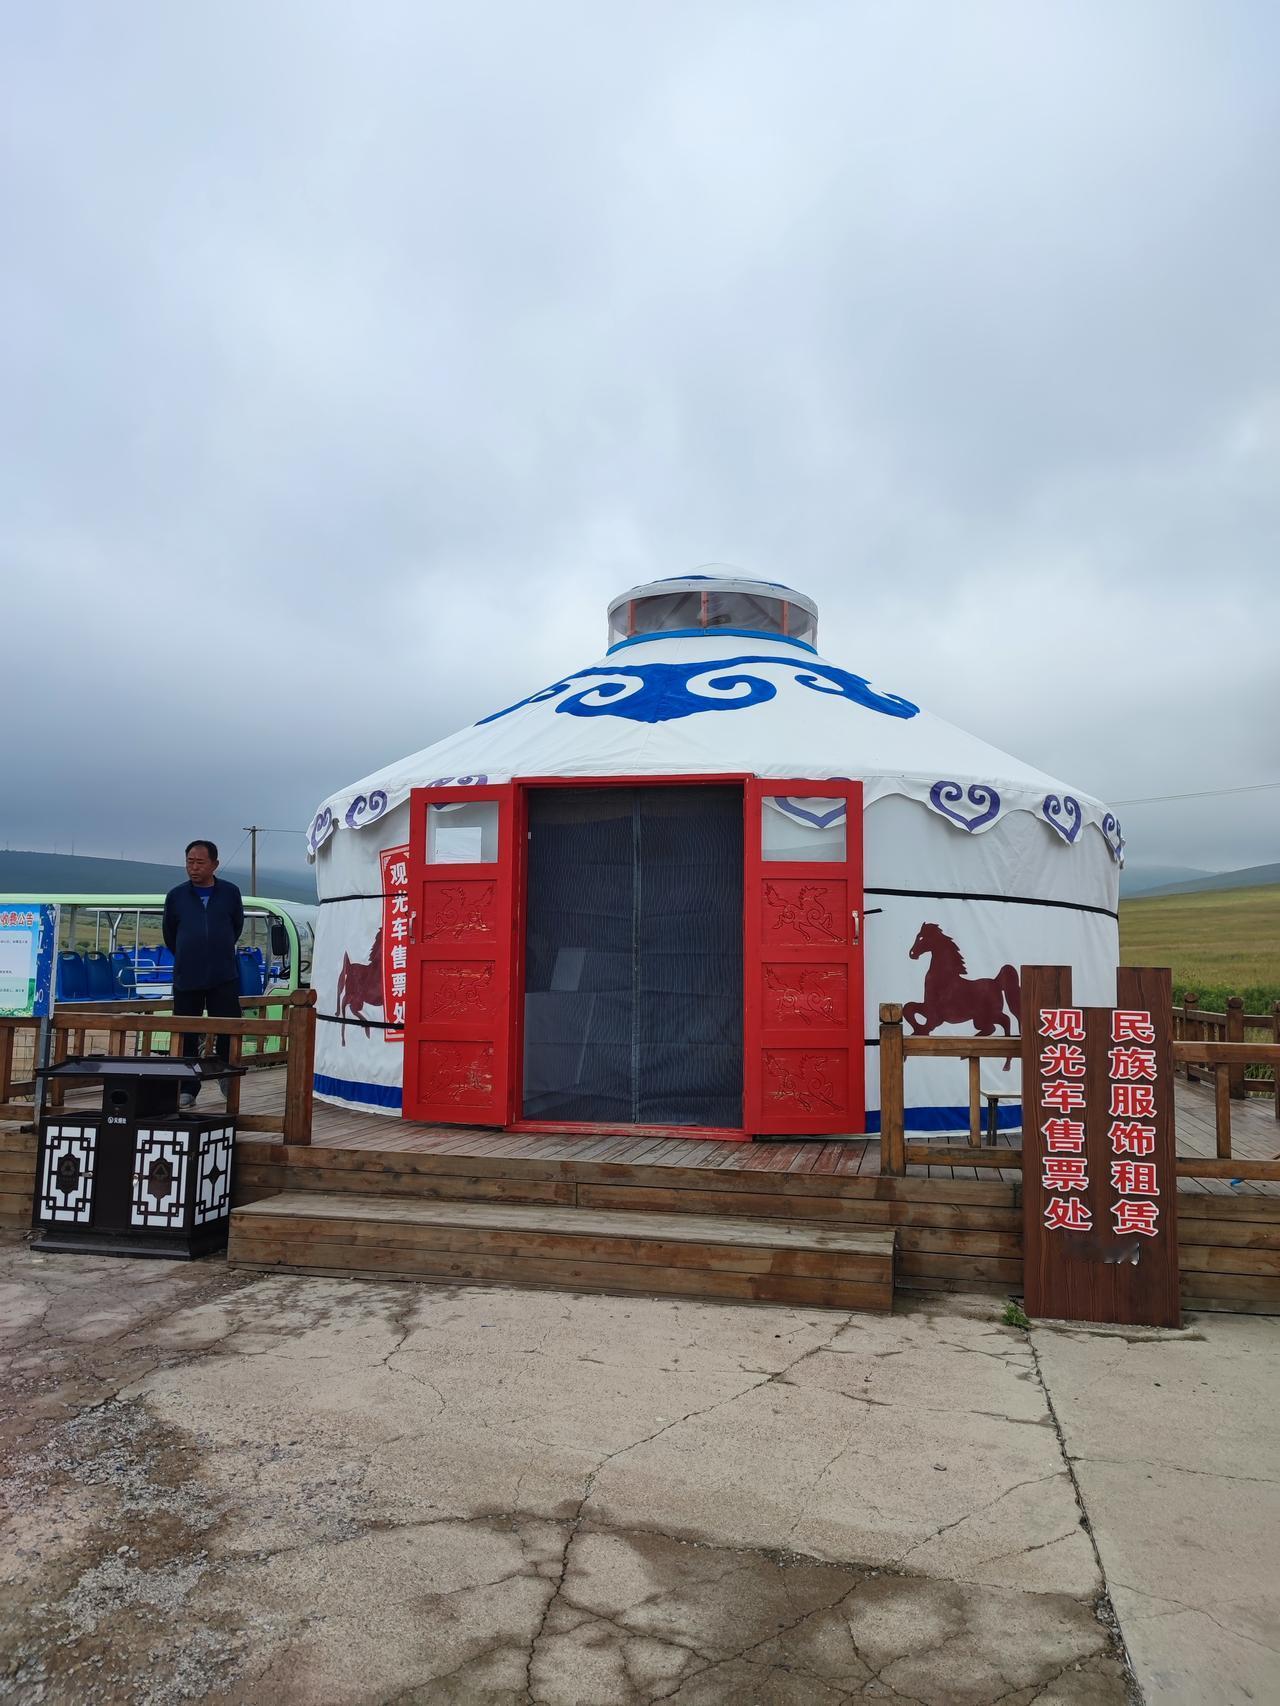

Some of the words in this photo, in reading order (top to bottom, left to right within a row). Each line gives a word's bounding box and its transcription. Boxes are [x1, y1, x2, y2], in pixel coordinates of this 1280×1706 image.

[390, 862, 408, 1024] 观光车售票处
[1039, 1008, 1094, 1232] 观光车售票处
[1108, 1010, 1160, 1237] 民族服饰租赁
